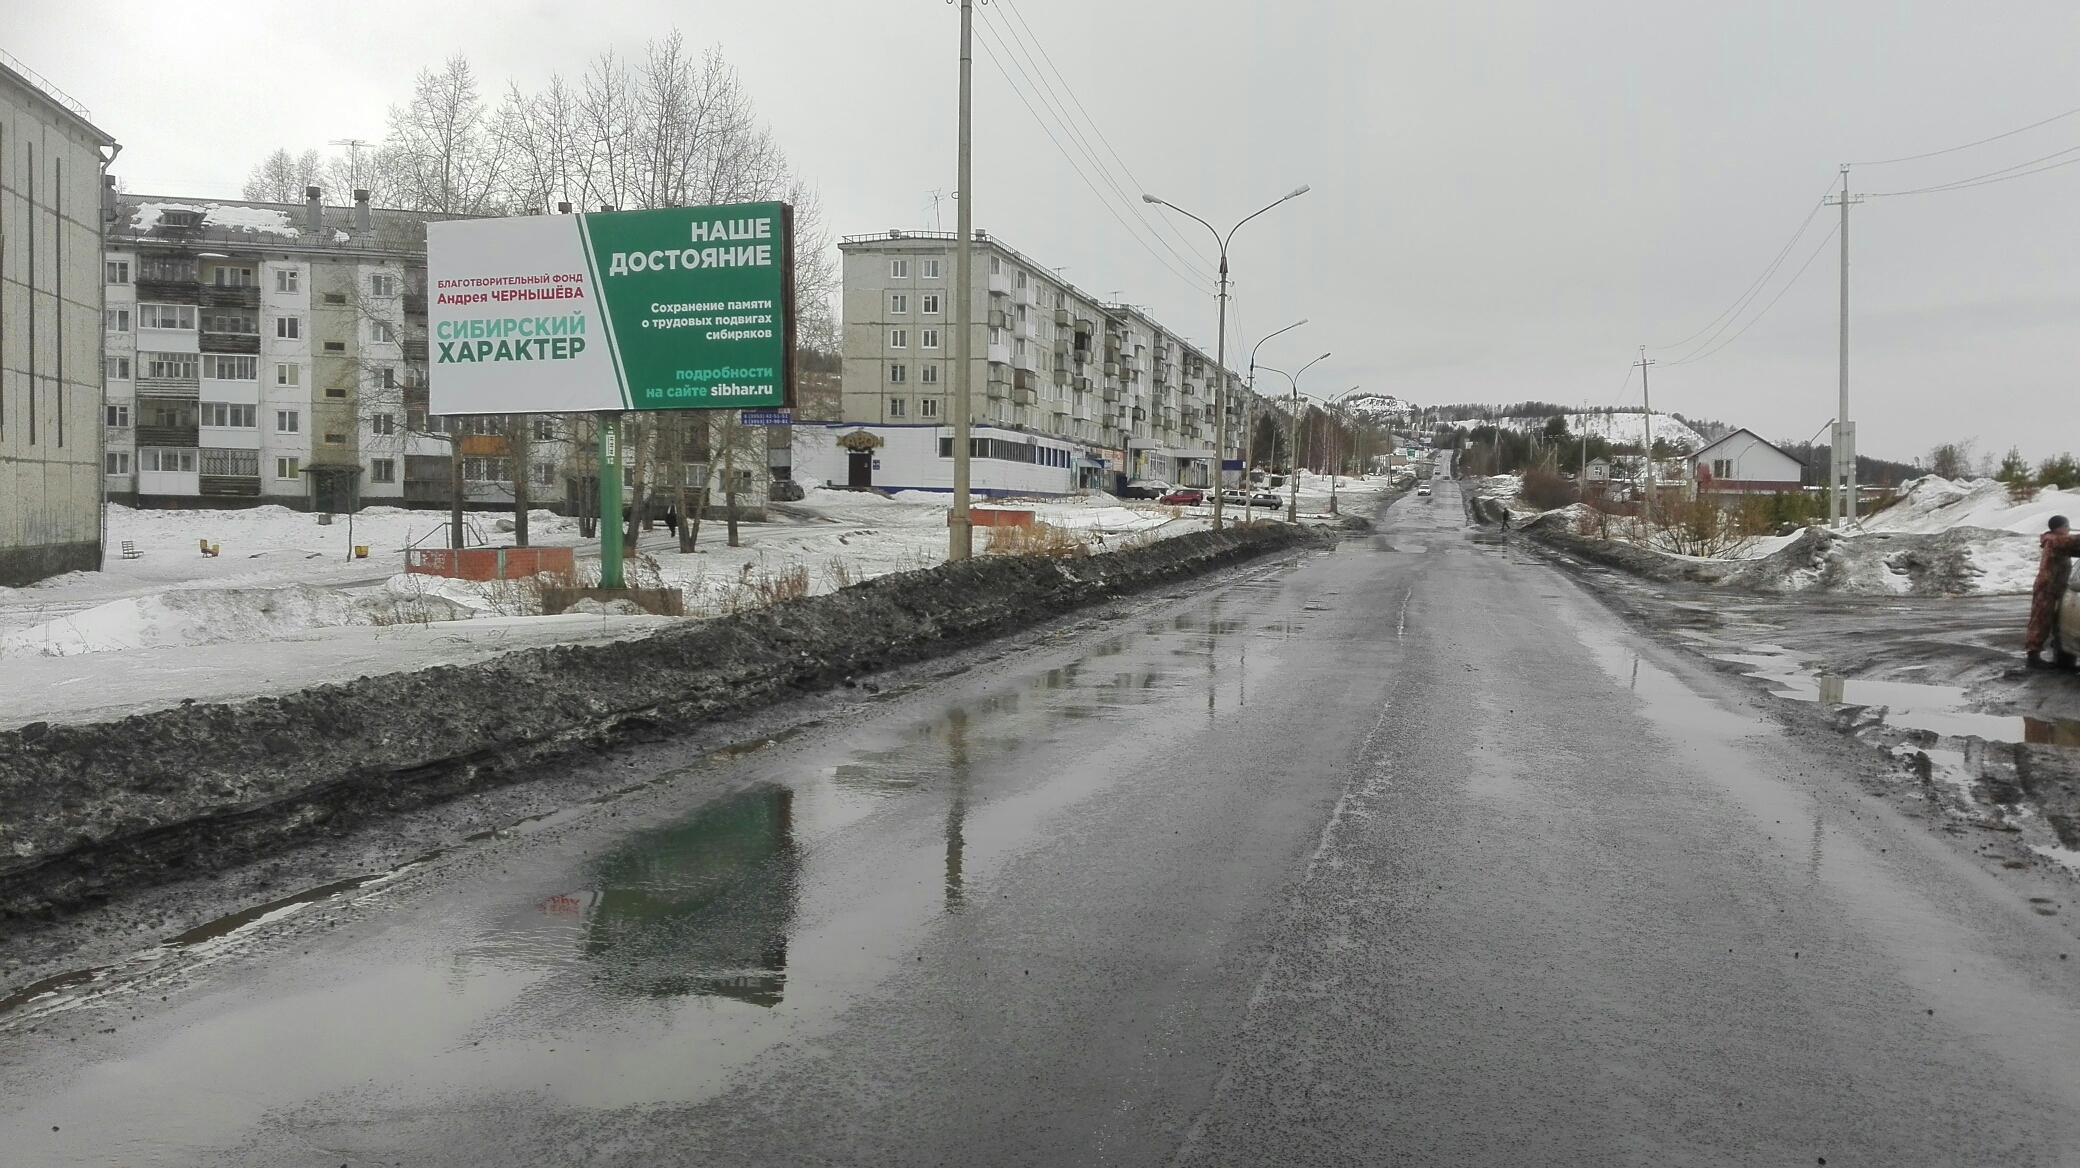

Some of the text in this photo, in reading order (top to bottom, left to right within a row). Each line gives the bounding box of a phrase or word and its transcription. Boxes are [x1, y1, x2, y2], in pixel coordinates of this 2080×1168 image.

[691, 217, 771, 242] НАШЕ
[609, 244, 772, 277] ДОСТОЯНИЕ
[437, 273, 583, 289] БЛАГОТВОРИТЕЛЬНЫЙ ФОНД
[437, 285, 584, 306] Андрея ЧЕРНЫШЁВА
[651, 299, 772, 314] Сохранение памяти
[436, 310, 586, 340] СИБИРСКИЙ
[641, 314, 772, 329] о трудовых подвигах
[705, 328, 772, 341] сибиряков
[437, 337, 586, 364] ХАРАКТЕР
[676, 366, 773, 382] подробности
[646, 383, 773, 398] на сайте sibhar.ru
[836, 434, 884, 448] ХАРОН
